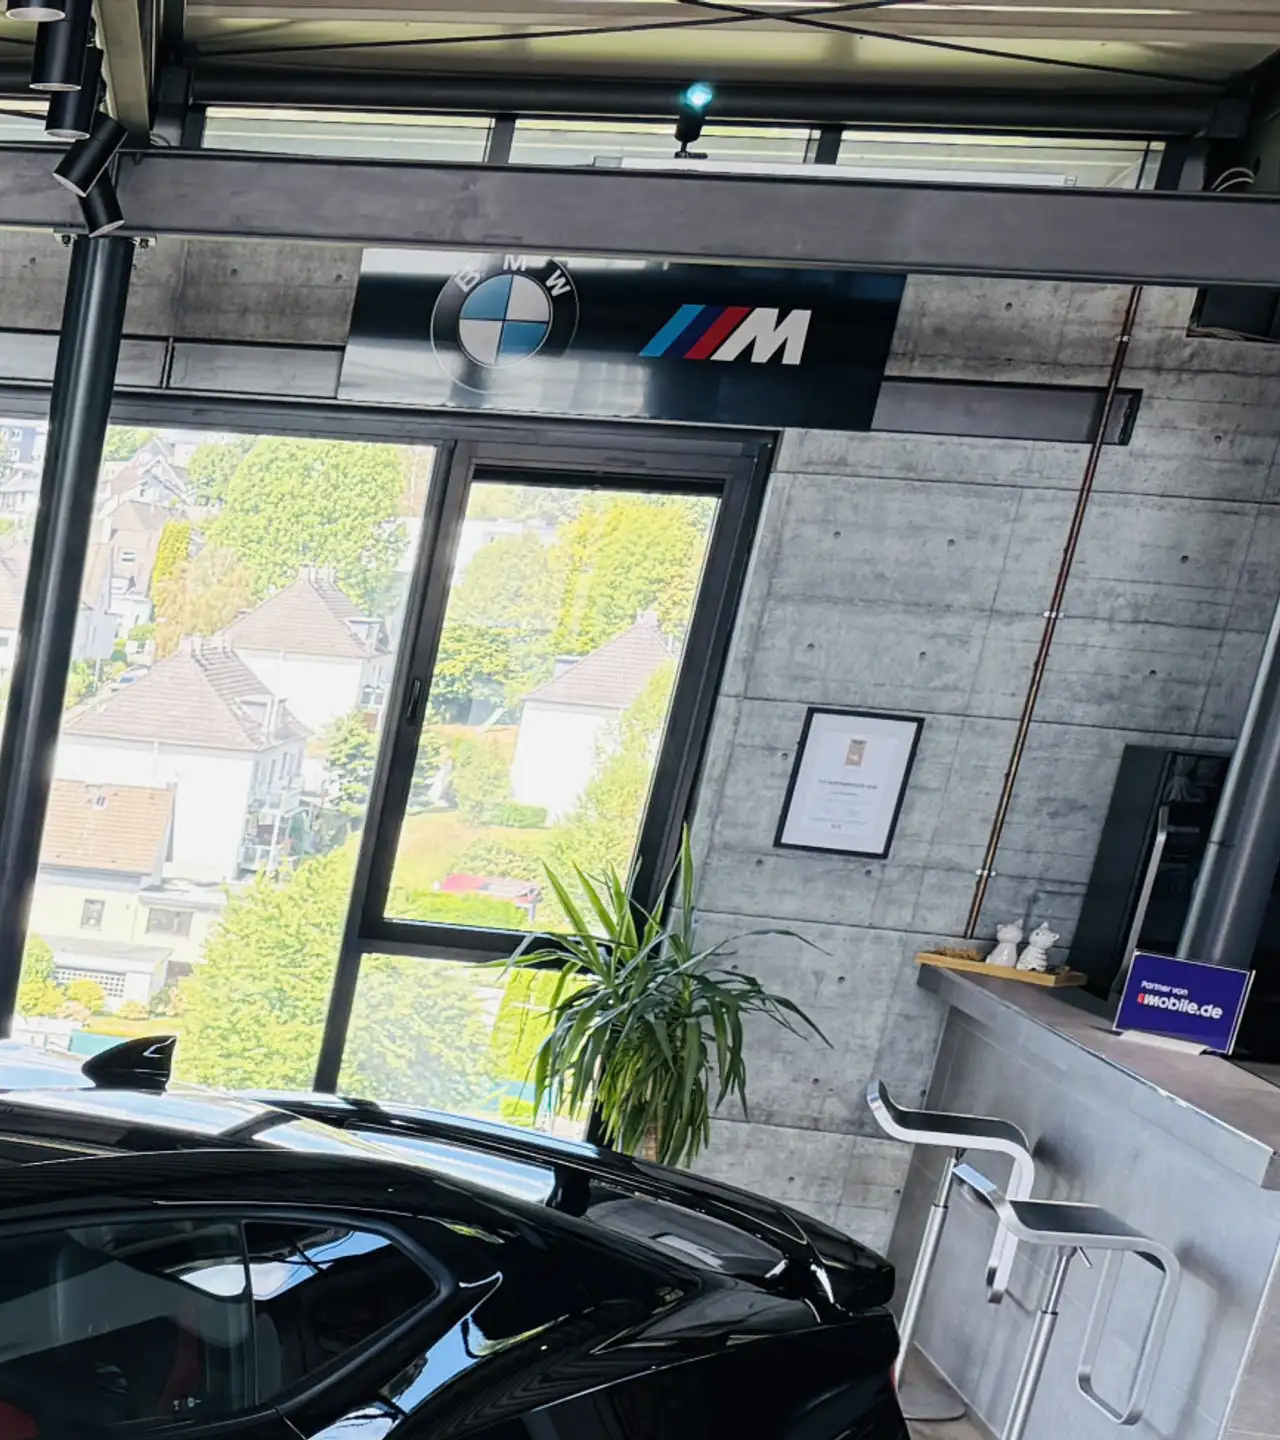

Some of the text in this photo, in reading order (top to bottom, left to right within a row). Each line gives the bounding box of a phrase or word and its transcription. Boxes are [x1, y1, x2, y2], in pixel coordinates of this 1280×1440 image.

[453, 253, 571, 297] BMW
[1140, 980, 1189, 997] Partner von
[1144, 992, 1224, 1020] mobile.de
